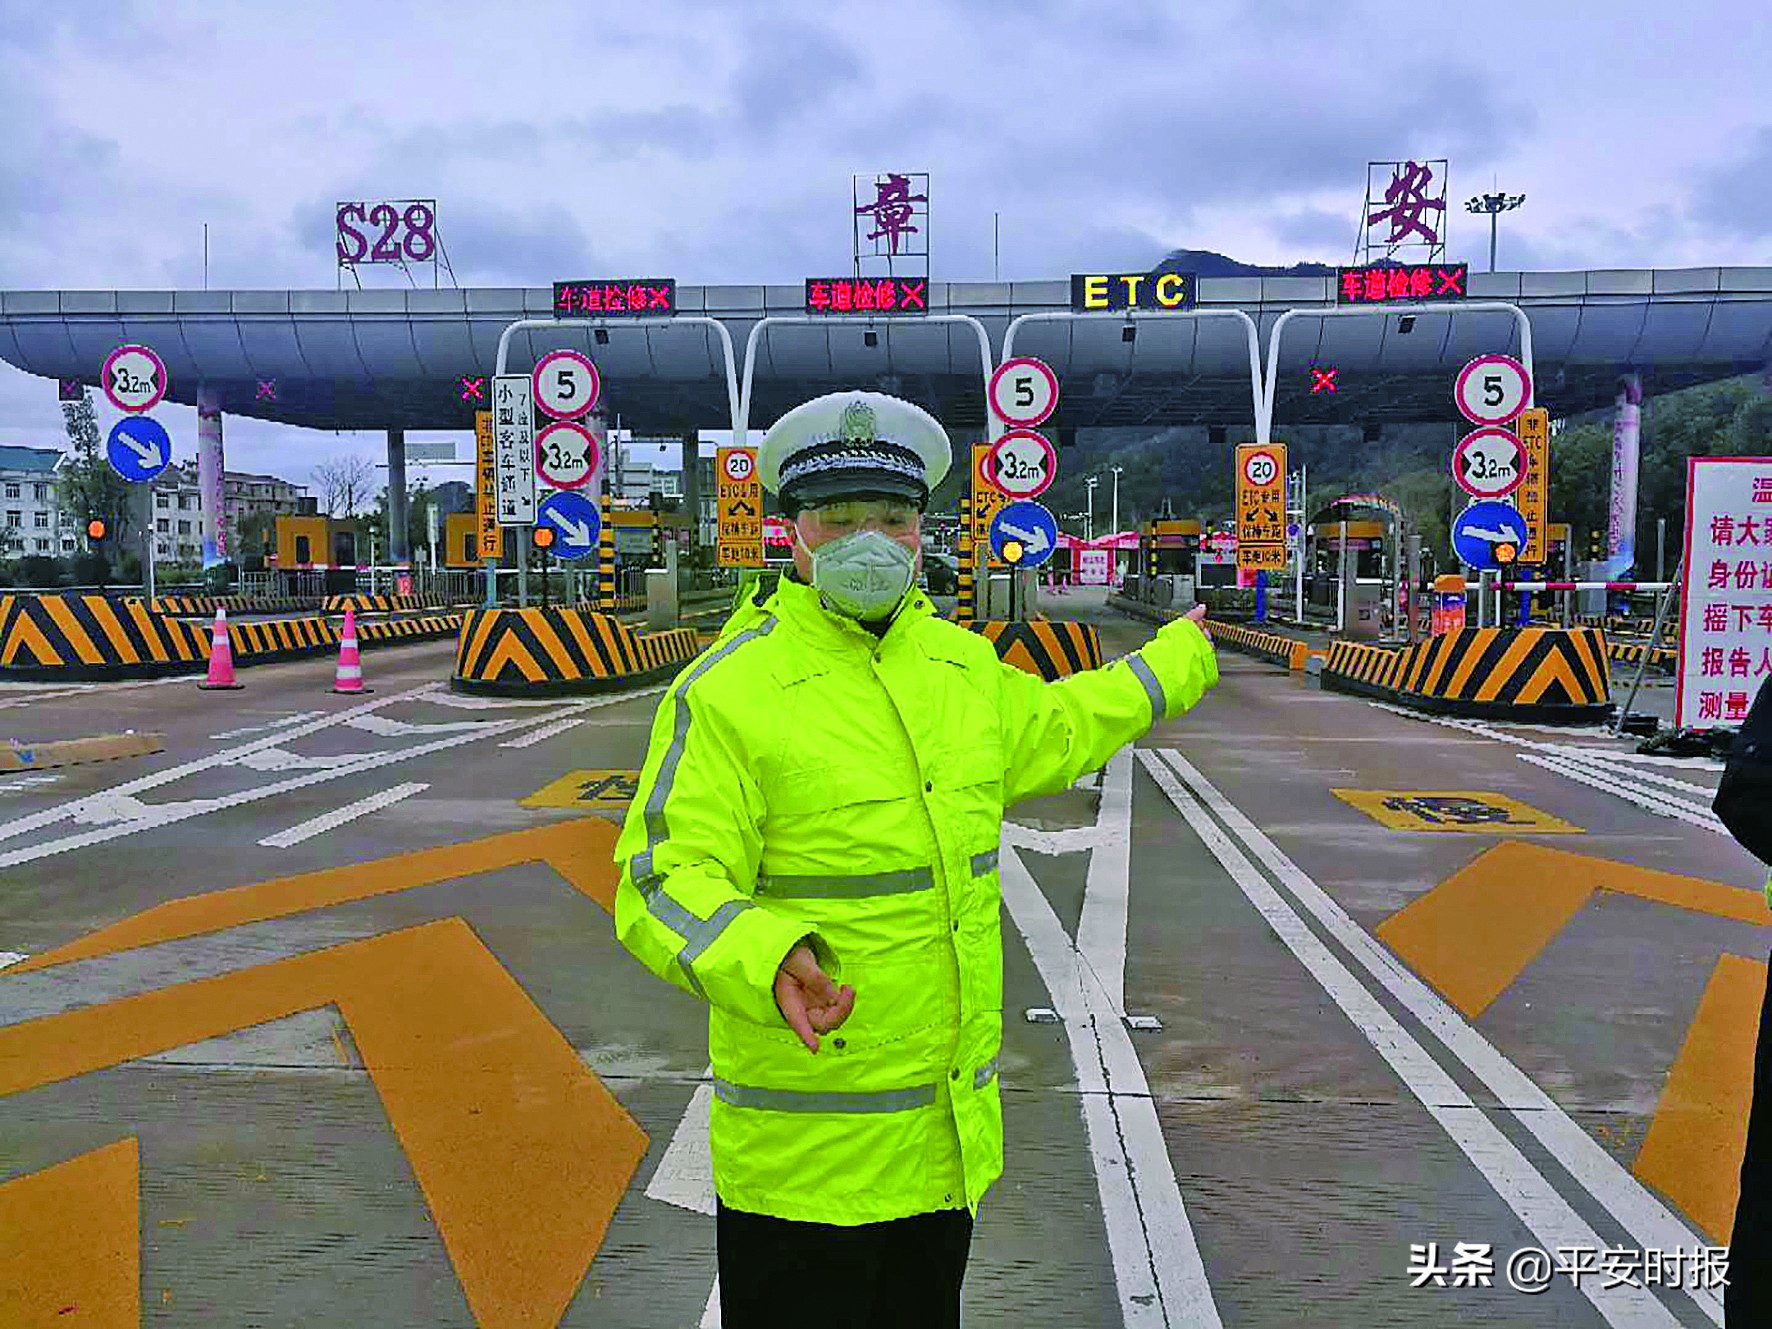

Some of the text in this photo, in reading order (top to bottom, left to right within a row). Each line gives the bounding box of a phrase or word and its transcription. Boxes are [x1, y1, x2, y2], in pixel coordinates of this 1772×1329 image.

[855, 173, 928, 255] 章
[1368, 161, 1446, 243] 安
[336, 203, 434, 263] S28
[809, 282, 896, 311] 车道检修
[1084, 273, 1184, 309] ETC
[1341, 267, 1433, 304] 车道检修
[117, 369, 151, 396] 3.2m
[557, 371, 577, 399] 5
[1014, 377, 1035, 407] 5
[1482, 376, 1505, 407] 5
[549, 443, 583, 470] 3.2m
[730, 459, 749, 473] 20
[1004, 452, 1039, 479] 3.2m
[1252, 462, 1272, 478] 20
[1471, 450, 1511, 479] 3.2m
